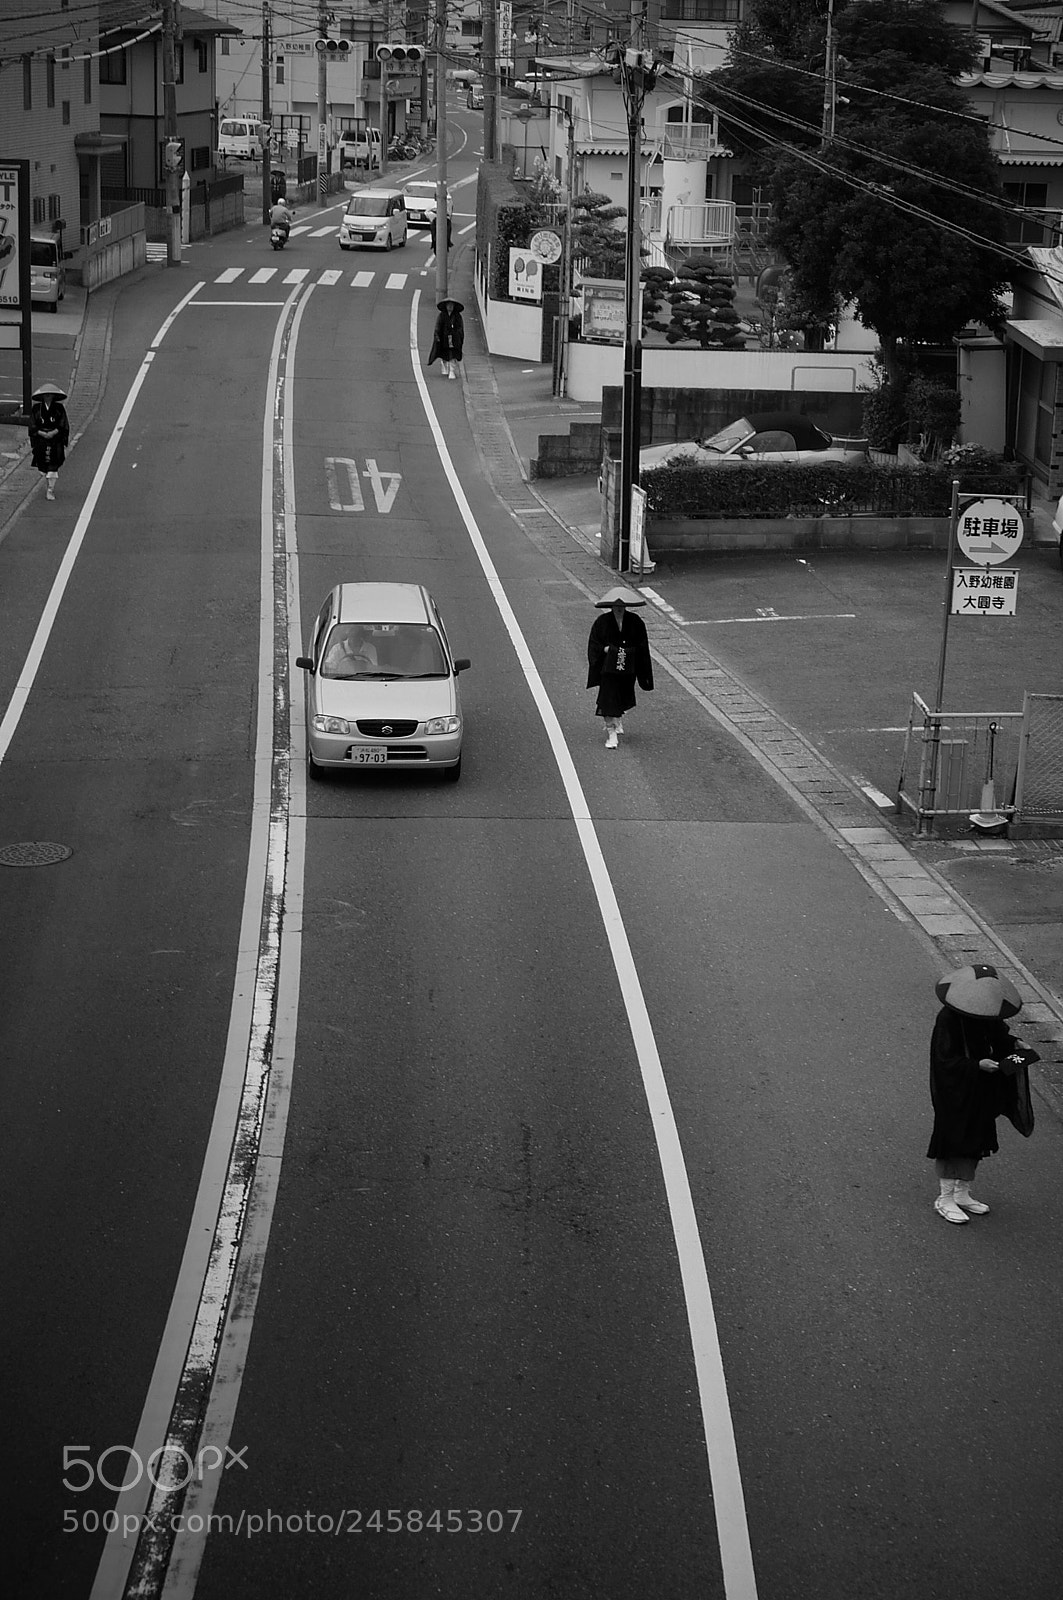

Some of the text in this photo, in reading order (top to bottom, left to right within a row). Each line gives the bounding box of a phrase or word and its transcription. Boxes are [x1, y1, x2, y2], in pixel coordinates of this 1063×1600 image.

[324, 457, 402, 514] 40
[962, 517, 1019, 538] 駐車場
[957, 574, 1015, 589] 入野幼稚園
[963, 595, 1005, 609] 大圓寺
